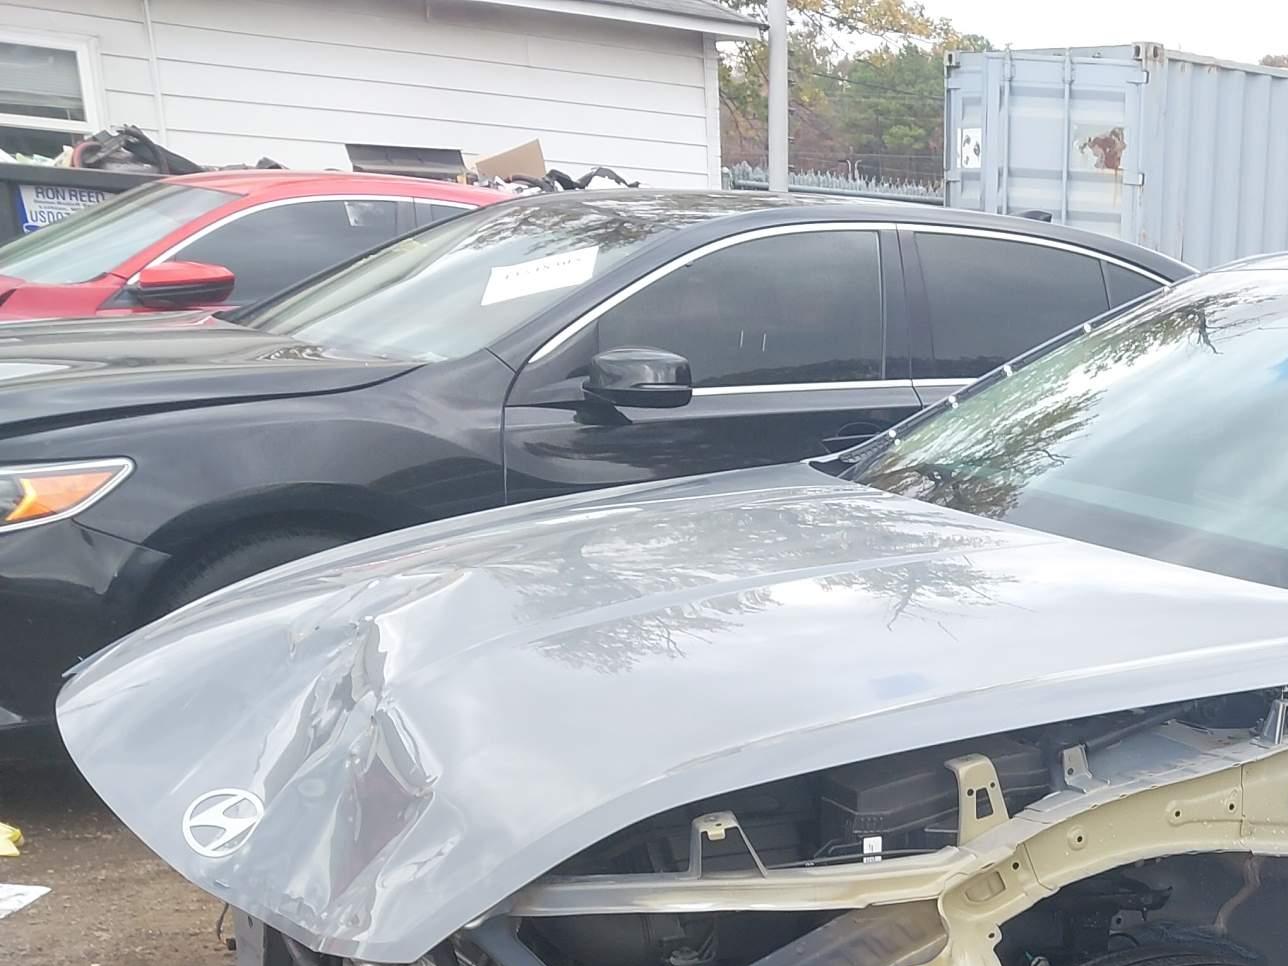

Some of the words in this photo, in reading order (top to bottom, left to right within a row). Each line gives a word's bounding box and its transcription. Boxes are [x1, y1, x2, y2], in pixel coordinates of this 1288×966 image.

[35, 186, 66, 200] RON
[69, 189, 105, 203] REED
[30, 210, 71, 224] USDO
